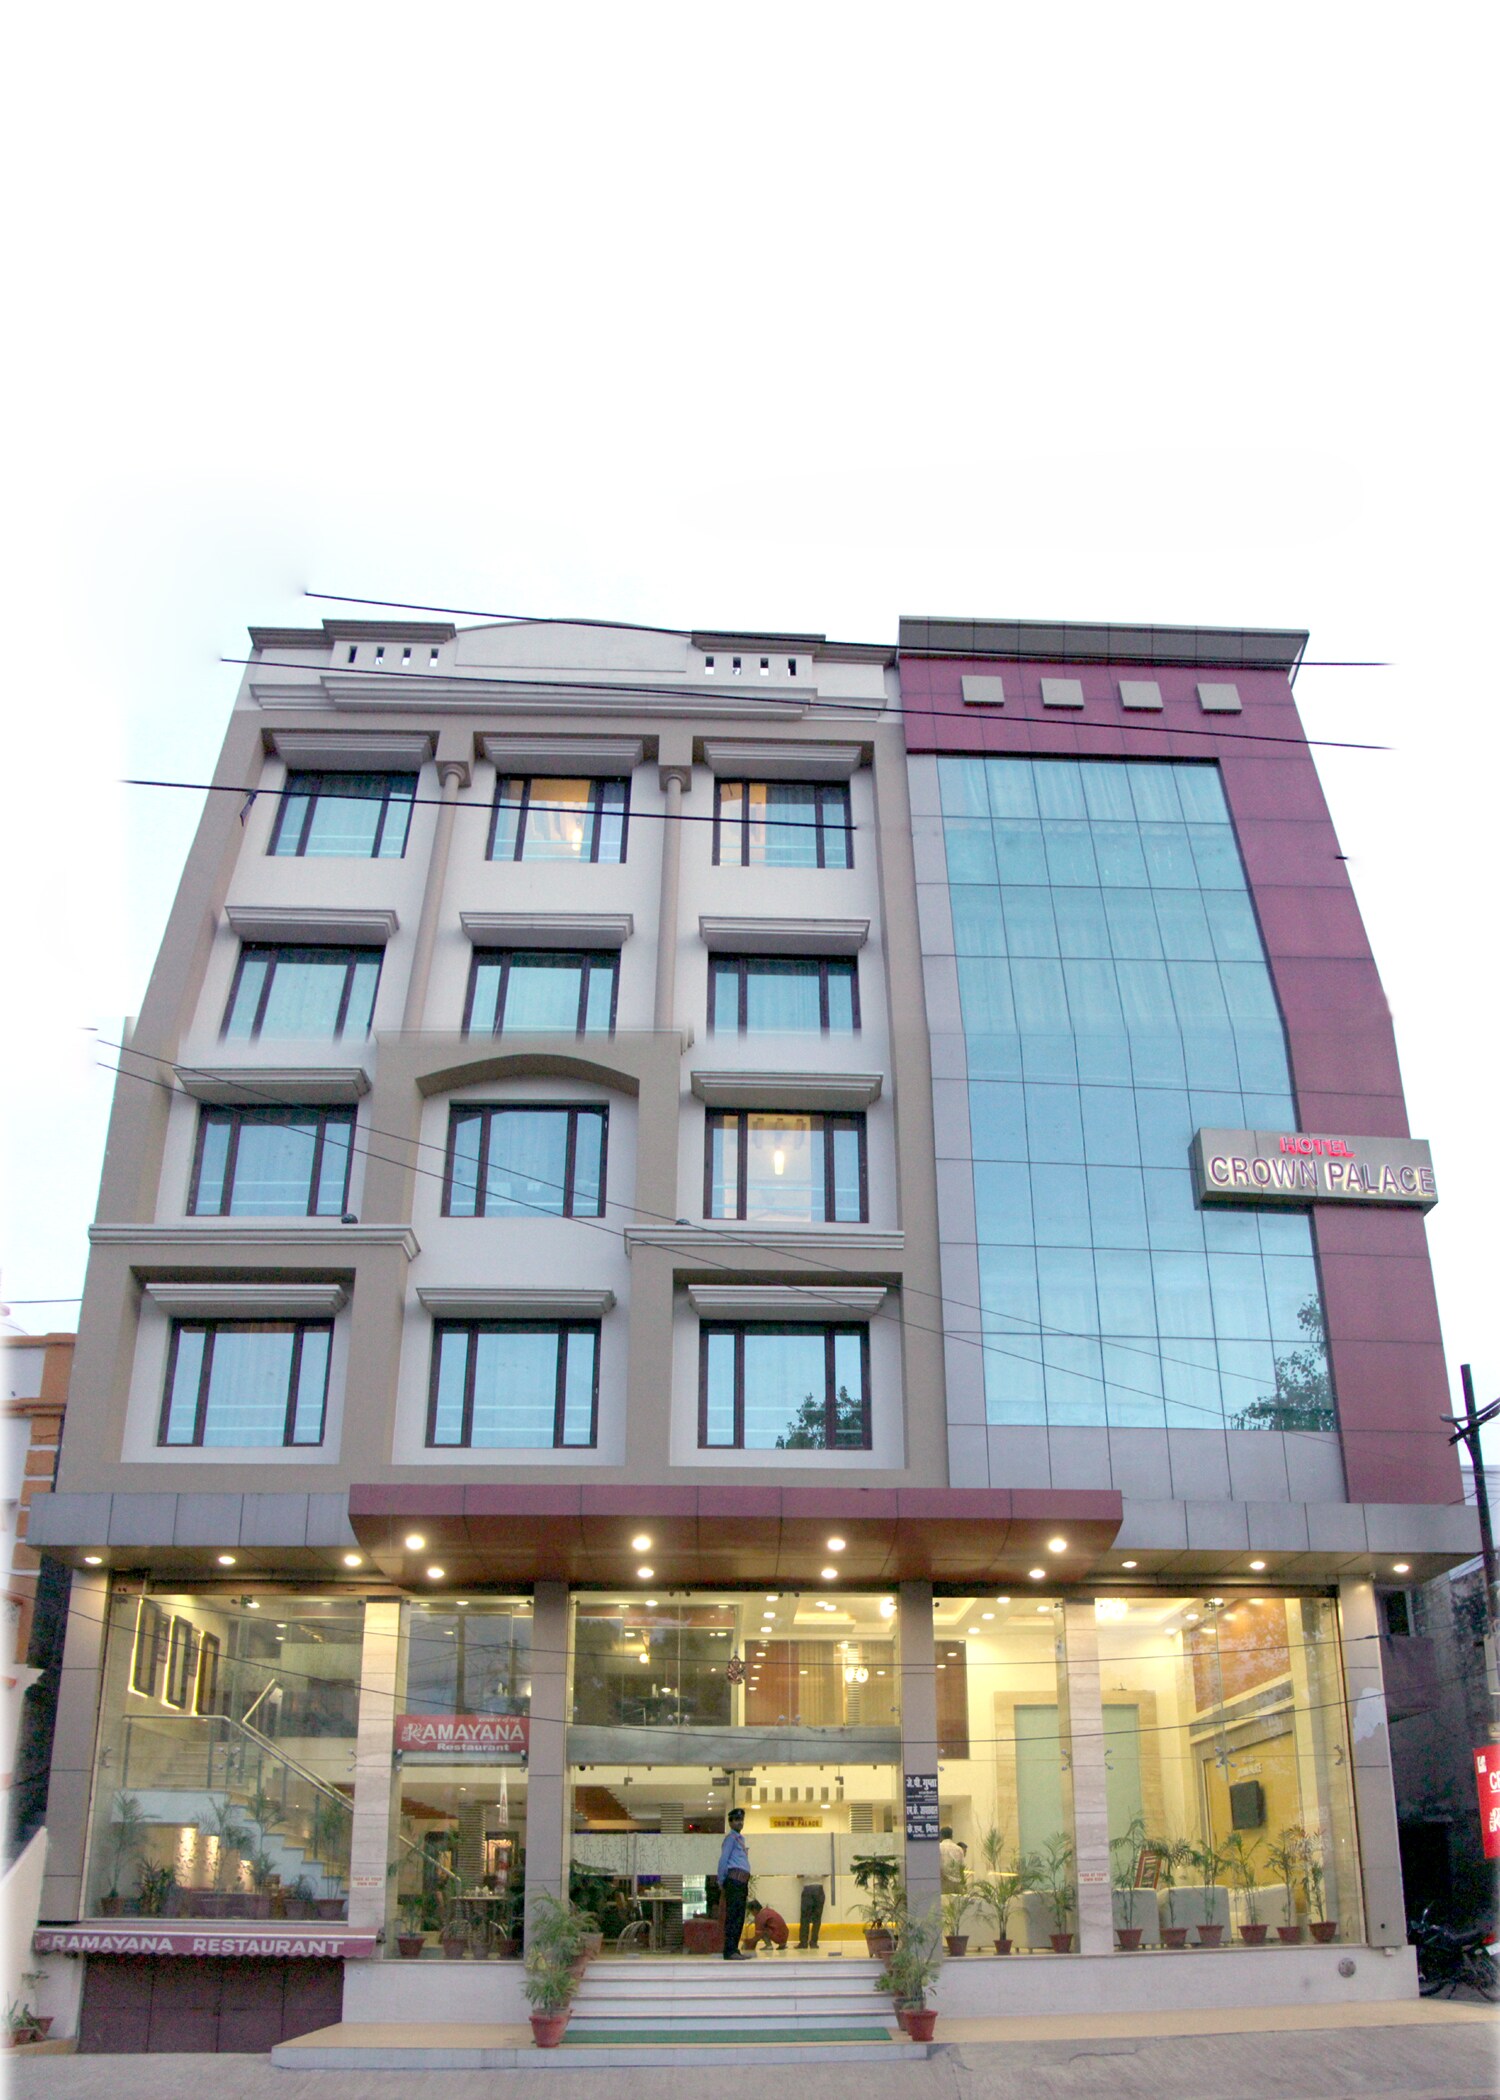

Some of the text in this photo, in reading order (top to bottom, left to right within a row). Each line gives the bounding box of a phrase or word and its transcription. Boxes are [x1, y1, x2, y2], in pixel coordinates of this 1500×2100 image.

[1280, 1137, 1355, 1158] HOTEL
[1209, 1156, 1435, 1196] CROWN PALACE
[407, 1723, 525, 1744] RAMAYANA
[437, 1743, 510, 1751] Restaurant
[774, 1820, 819, 1828] CROWN PALACE
[51, 1935, 174, 1951] RAMAYANA
[193, 1937, 344, 1954] RESTAURANT
